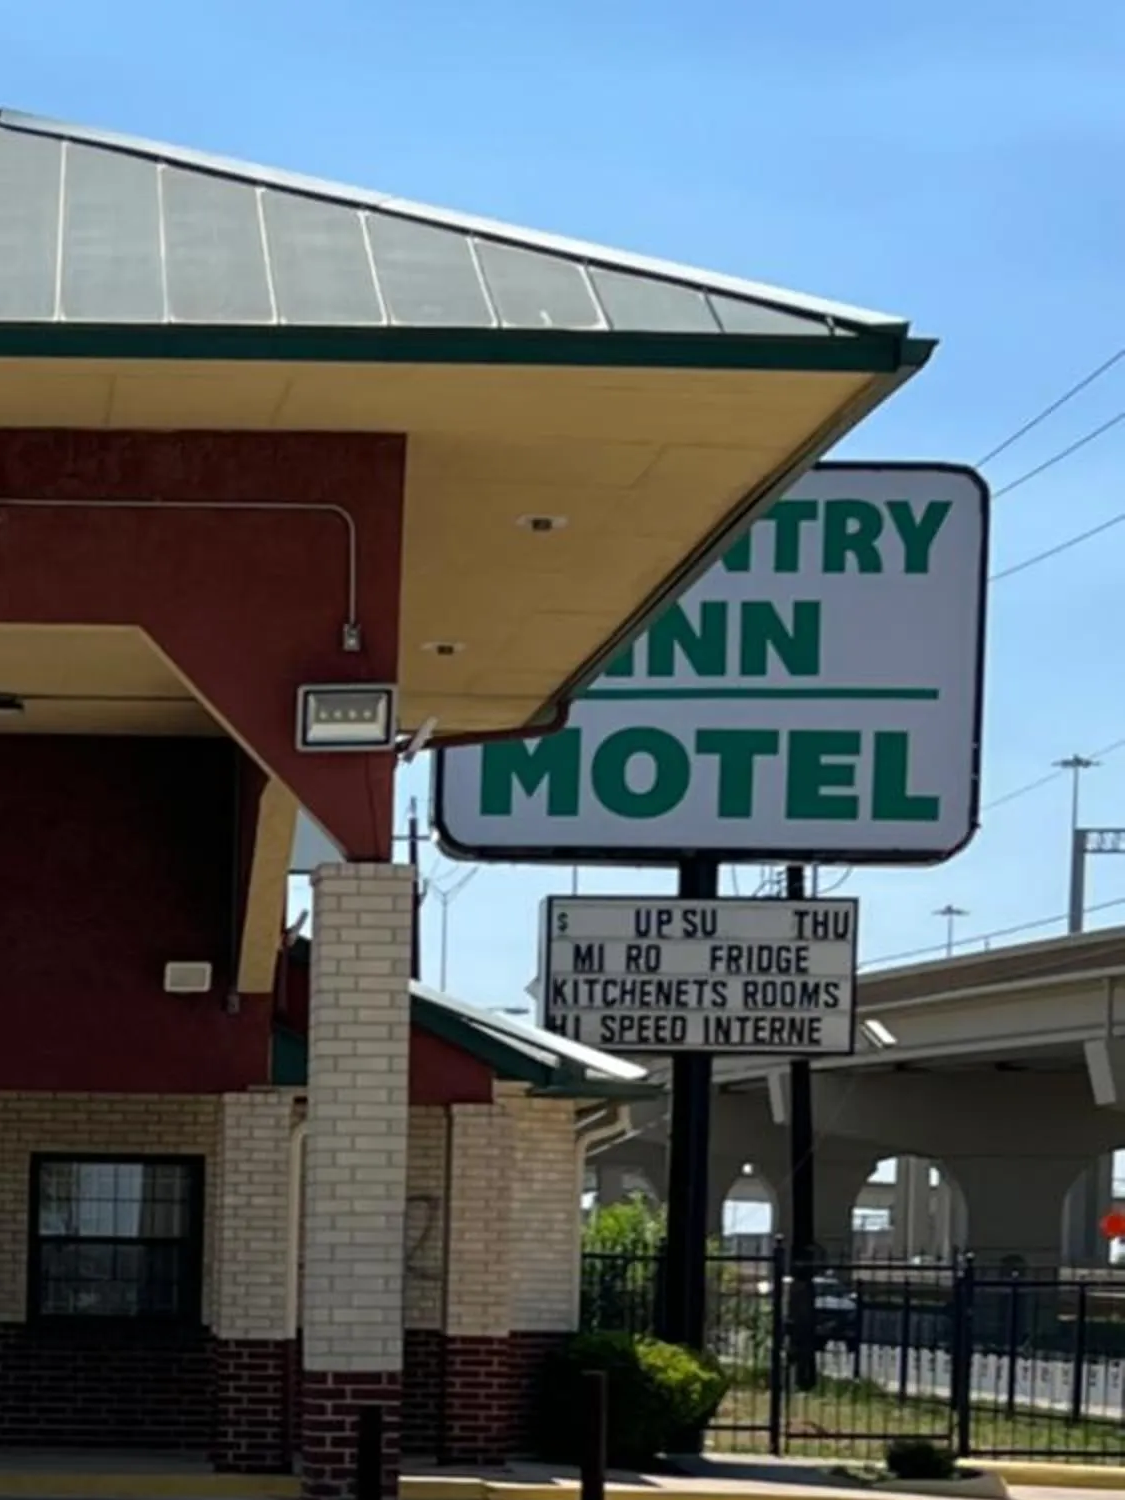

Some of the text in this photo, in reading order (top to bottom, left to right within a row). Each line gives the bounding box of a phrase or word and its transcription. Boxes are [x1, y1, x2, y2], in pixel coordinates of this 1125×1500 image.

[478, 725, 941, 822] MOTEL
[794, 910, 850, 940] THU
[710, 944, 810, 975] FRIDGE
[552, 978, 841, 1010] KITCHENETS ROOMS
[600, 1014, 689, 1045] SPEED
[703, 1015, 823, 1046] INTERNE
